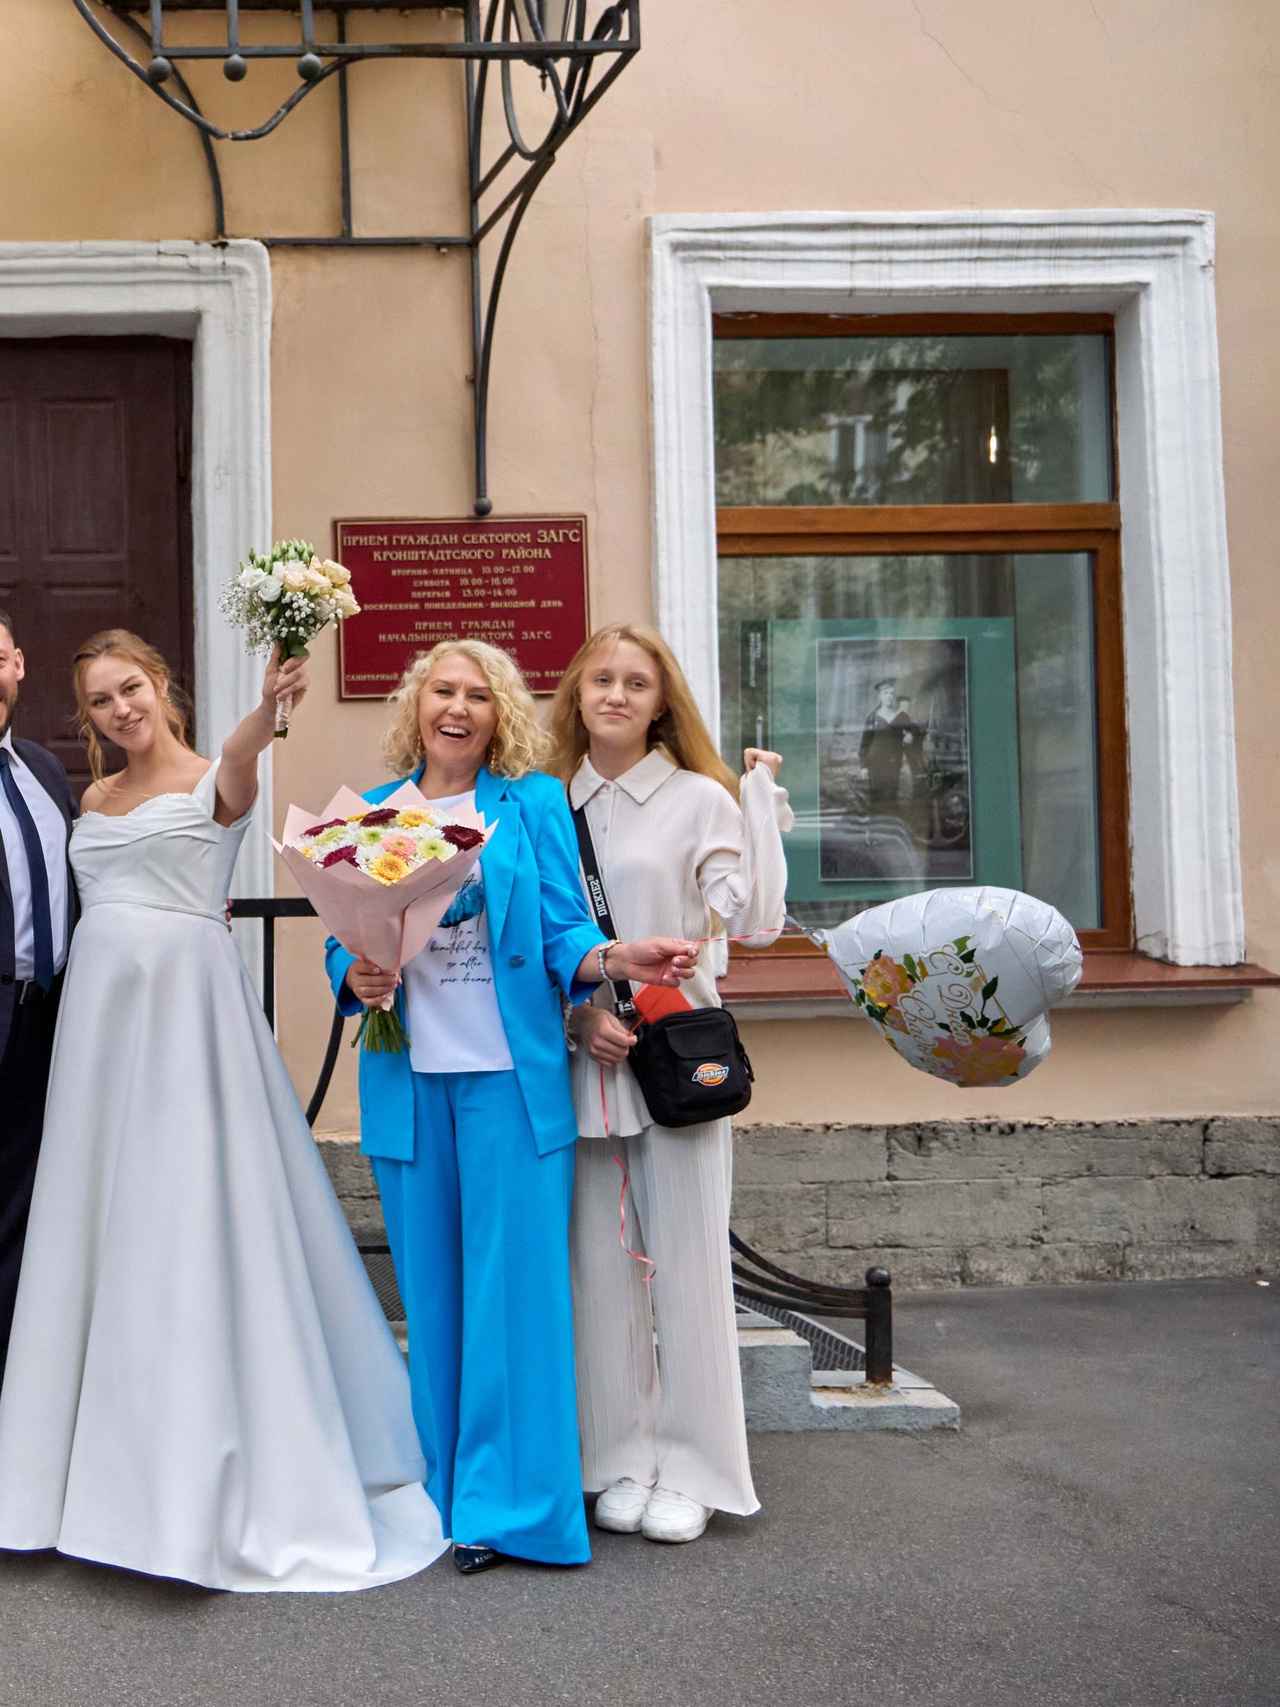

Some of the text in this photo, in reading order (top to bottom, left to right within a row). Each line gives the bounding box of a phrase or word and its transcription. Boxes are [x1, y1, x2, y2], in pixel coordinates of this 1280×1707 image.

[343, 530, 580, 546] ПРИЕМ ГРАЖДАН СЕКТОРОМ ЗАГС
[373, 547, 551, 561] КРОНШТАДТСКОГО РАЙОНА
[411, 591, 451, 599] ПЕРЕРЫВ
[415, 621, 515, 630] ПРИЕМ ГРАЖДАН
[379, 631, 552, 642] НАЧАЛЬНИКОМ СЕКТОРА ЗАГС
